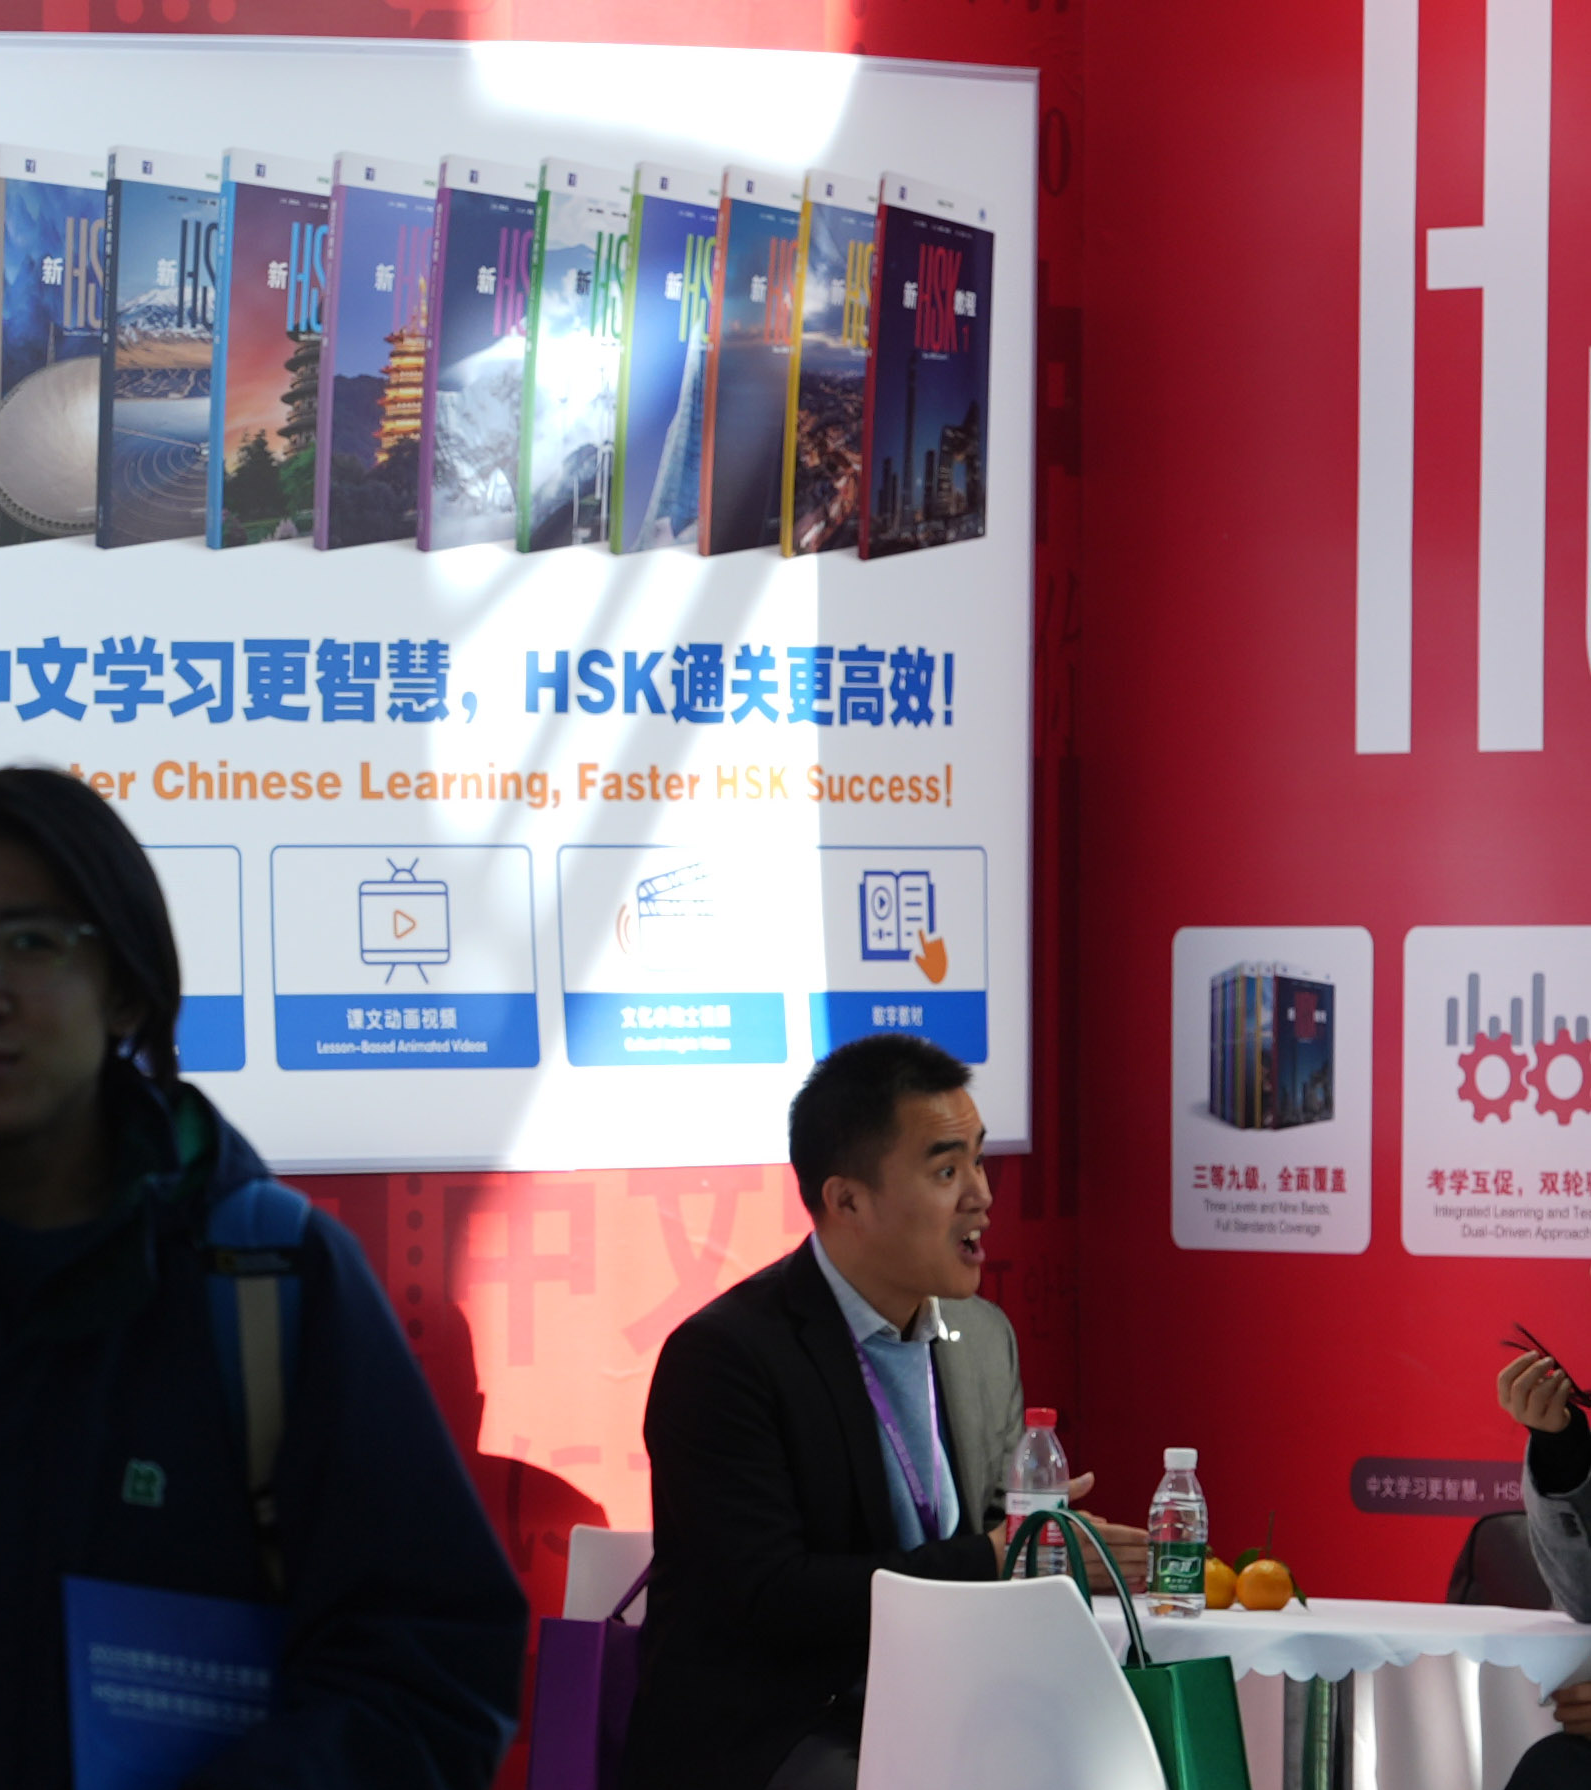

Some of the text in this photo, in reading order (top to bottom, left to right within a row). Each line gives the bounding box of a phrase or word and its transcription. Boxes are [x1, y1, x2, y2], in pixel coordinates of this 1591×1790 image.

[153, 760, 342, 801] Chinese
[360, 761, 561, 809] Learning,
[577, 763, 700, 801] Faster
[717, 764, 790, 800] HSK
[806, 764, 953, 807] Success!
[346, 1007, 457, 1030] 课文动画视频
[451, 1038, 489, 1053] Videos
[1433, 1204, 1491, 1220] Integrated
[1494, 1205, 1545, 1220] Learning
[1547, 1206, 1569, 1219] and
